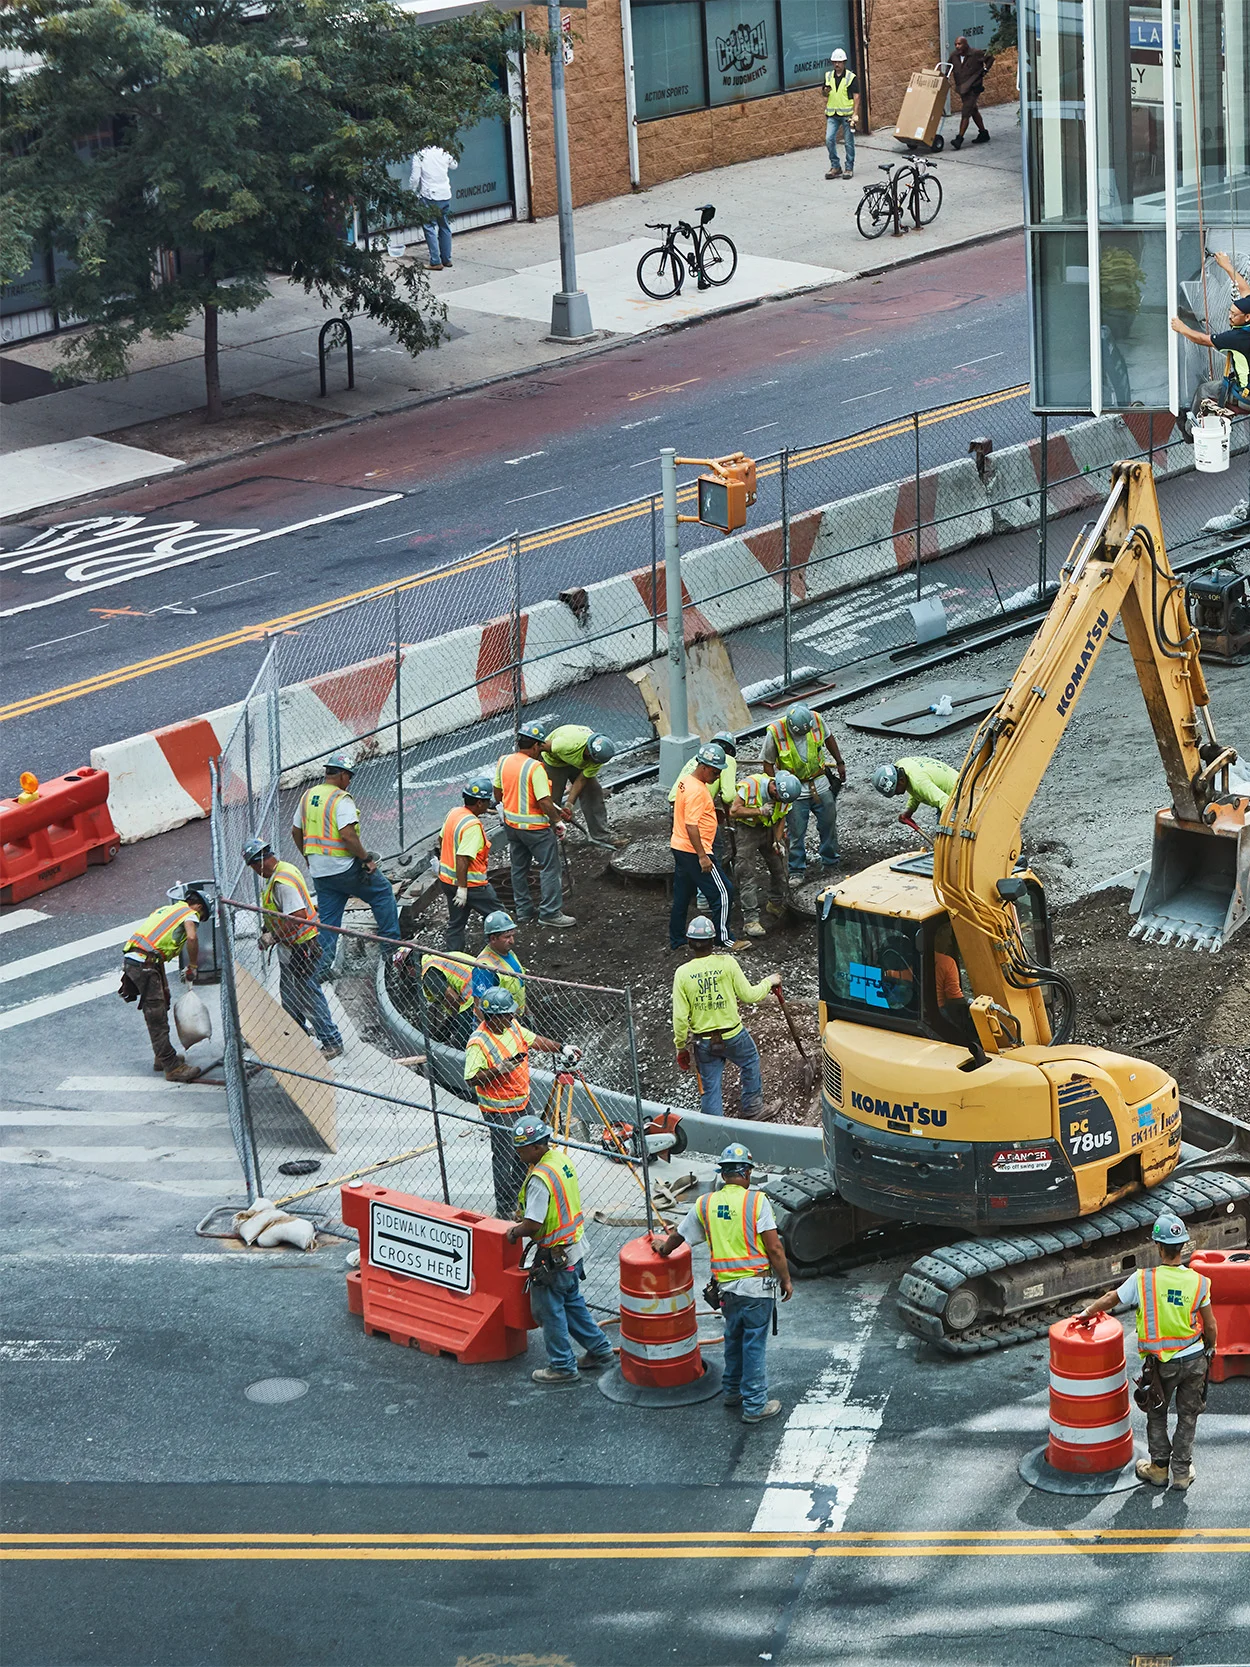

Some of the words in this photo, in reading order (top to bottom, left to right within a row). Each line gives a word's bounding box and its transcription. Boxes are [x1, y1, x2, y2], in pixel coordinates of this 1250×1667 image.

[963, 29, 972, 37] THE
[972, 25, 984, 35] RIDE
[715, 20, 768, 72] CRUNCH
[722, 75, 732, 86] NO
[732, 65, 768, 86] JUDGMENTS
[794, 61, 813, 74] DANCE
[644, 90, 667, 102] ACTION
[666, 84, 690, 98] SPORTS
[456, 181, 497, 200] CRUNCH.COM
[1056, 608, 1109, 717] KOMATSU
[698, 977, 718, 994] SAFE
[695, 994, 712, 1002] IT'S
[851, 1090, 947, 1127] KOMATSU
[1069, 1118, 1089, 1137] PC
[1131, 1122, 1159, 1147] EK111
[1069, 1130, 1113, 1155] 78US
[376, 1212, 427, 1238] SIDEWALK
[429, 1228, 464, 1249] CLOSED
[379, 1244, 422, 1269] CROSS
[427, 1258, 462, 1281] HERE
